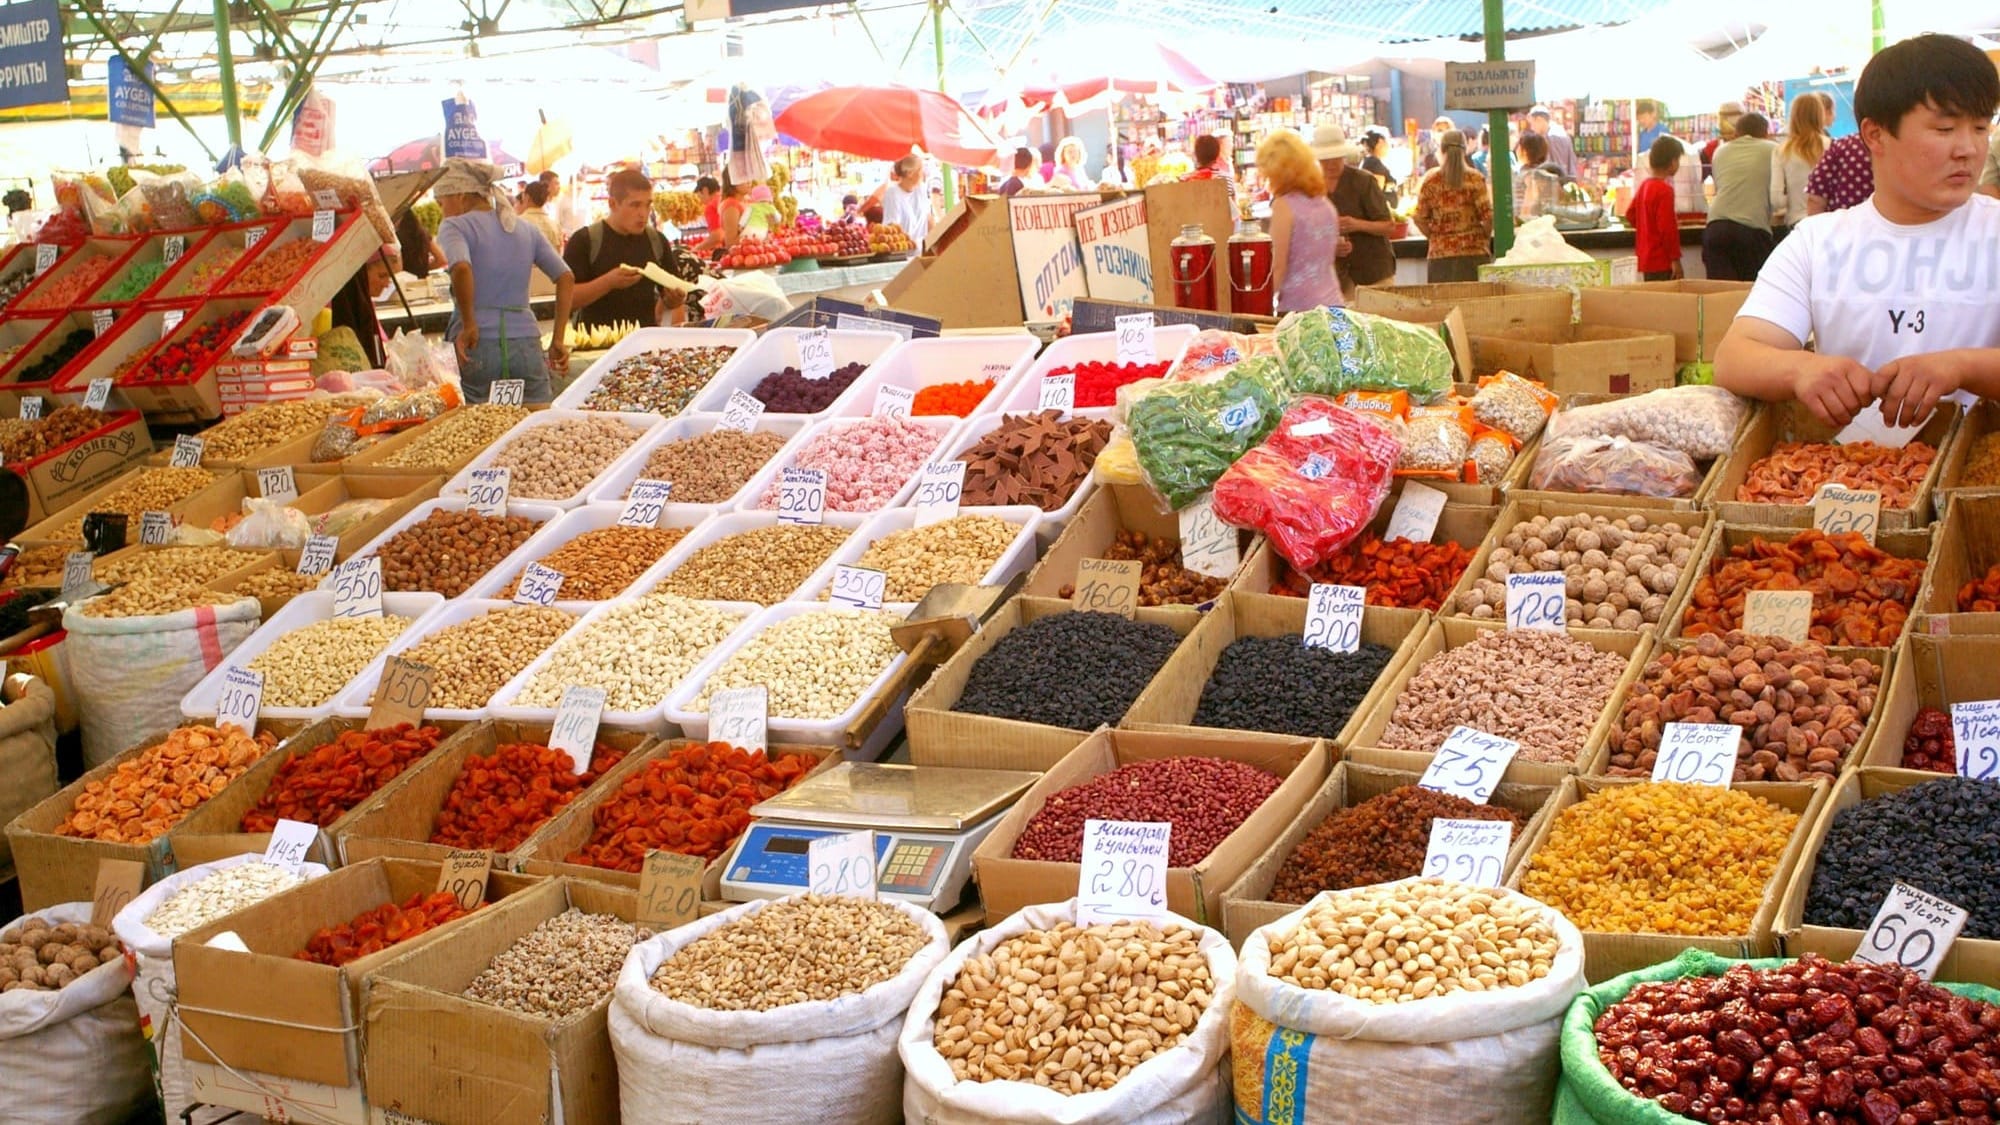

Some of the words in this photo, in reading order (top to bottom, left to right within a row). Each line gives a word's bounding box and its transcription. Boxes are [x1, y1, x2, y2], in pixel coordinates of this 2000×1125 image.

[1824, 237, 1998, 294] YOHJI
[1888, 309, 1925, 334] Y-3
[495, 384, 522, 406] 350
[69, 438, 118, 469] ROSHEN
[468, 485, 504, 505] 300
[780, 487, 822, 512] 320
[916, 481, 960, 507] 350
[620, 502, 661, 524] 550
[335, 571, 380, 604] 350
[518, 577, 556, 605] 350
[1303, 618, 1359, 649] 200
[382, 668, 430, 708] 150
[221, 689, 256, 719] 180
[1659, 746, 1733, 784] 105
[814, 857, 872, 896] 280
[643, 883, 695, 916] 120
